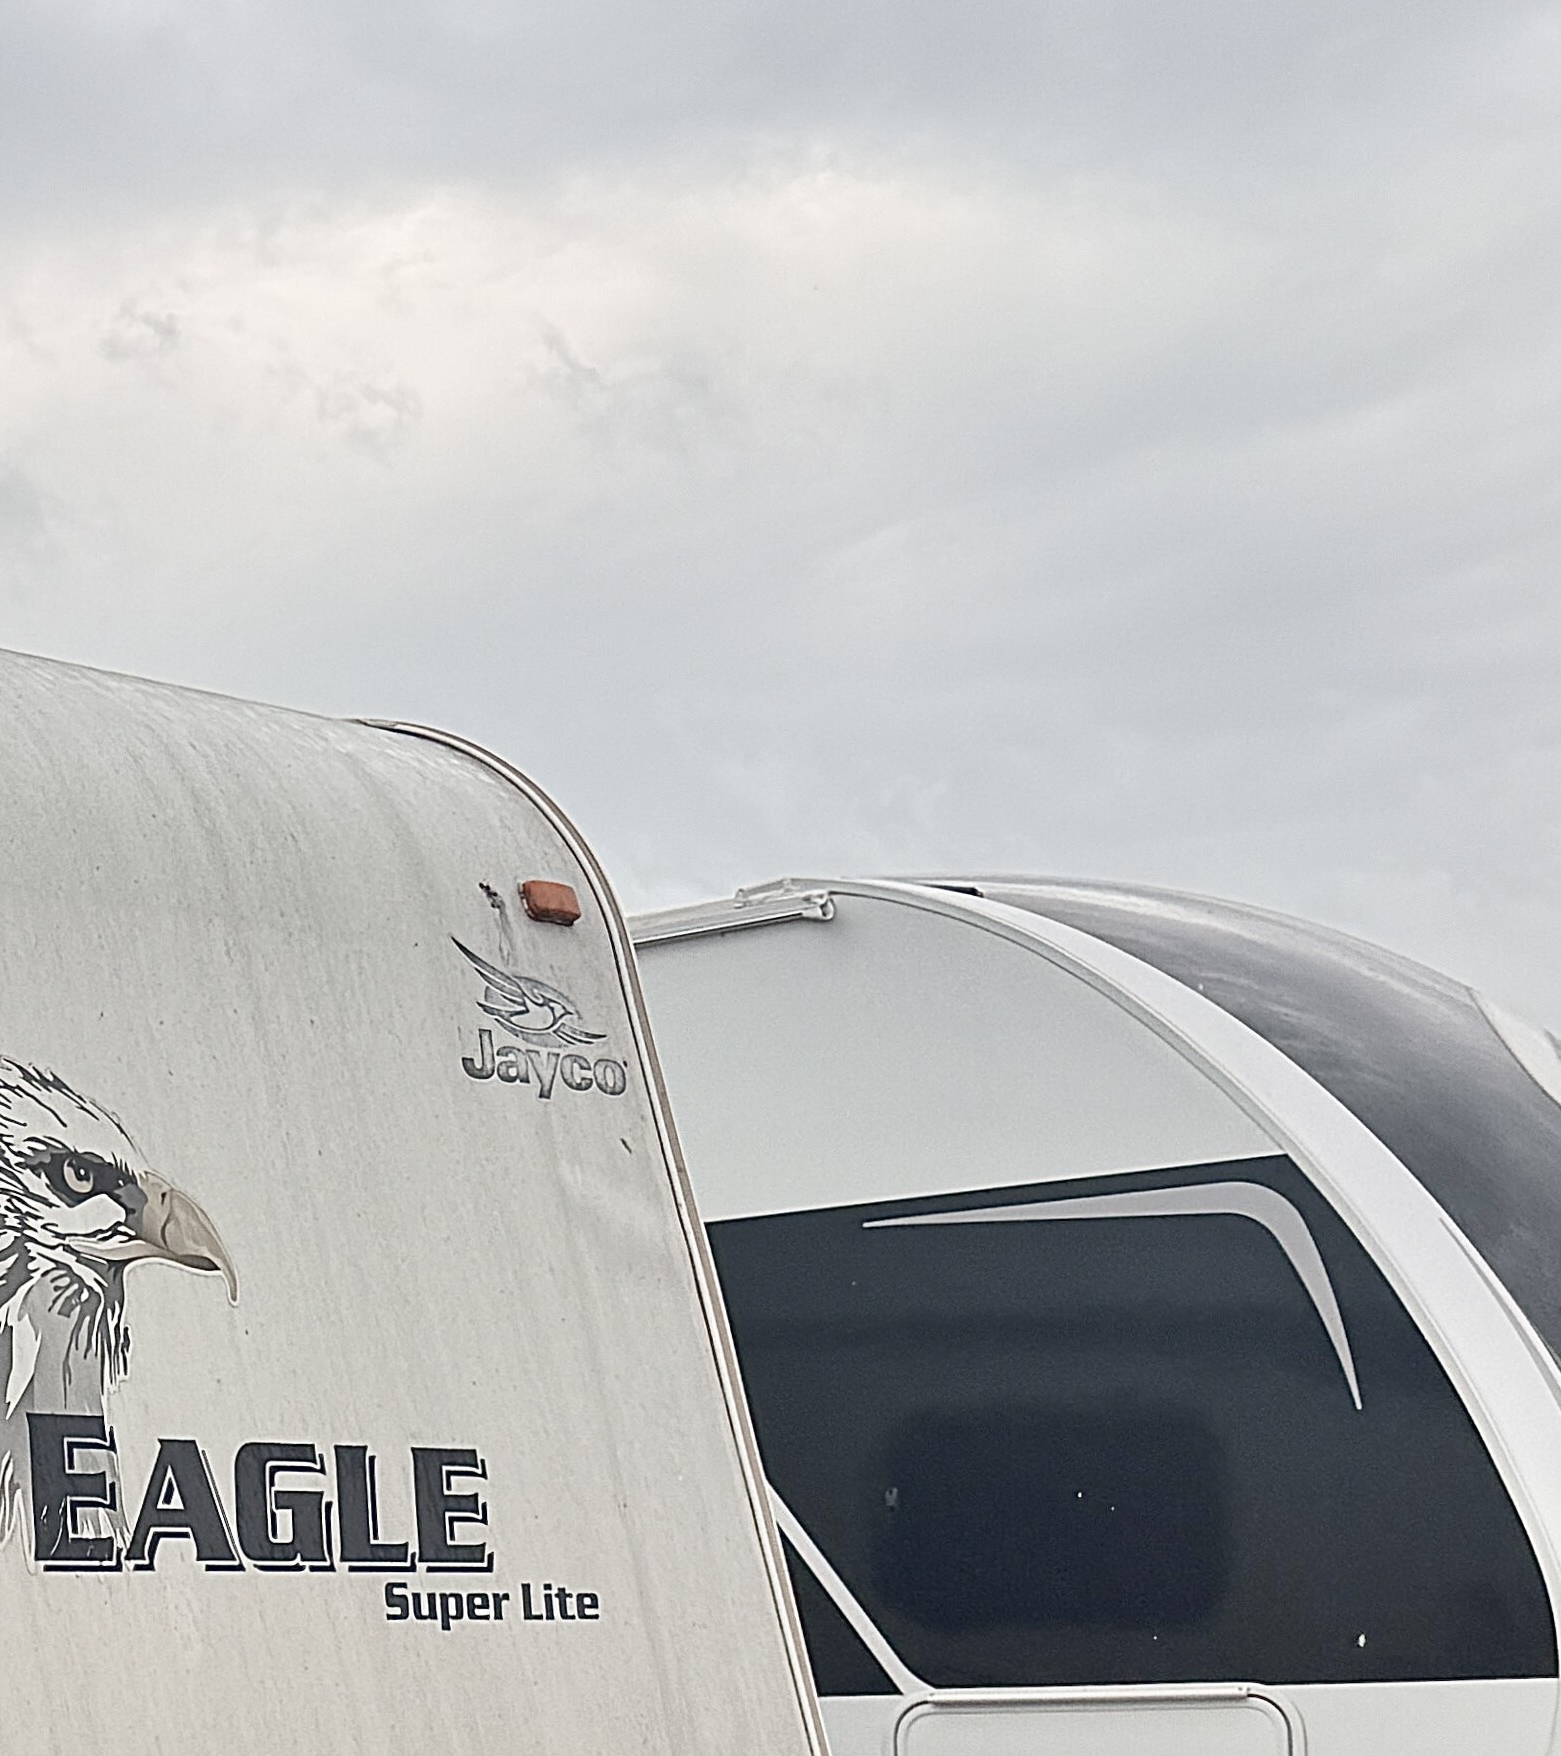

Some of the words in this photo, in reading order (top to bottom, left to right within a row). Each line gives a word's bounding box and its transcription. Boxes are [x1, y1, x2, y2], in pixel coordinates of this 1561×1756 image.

[462, 1028, 627, 1099] Jayco
[27, 1412, 495, 1573] EAGLE
[385, 1582, 509, 1631] Super
[521, 1583, 599, 1620] Lite
